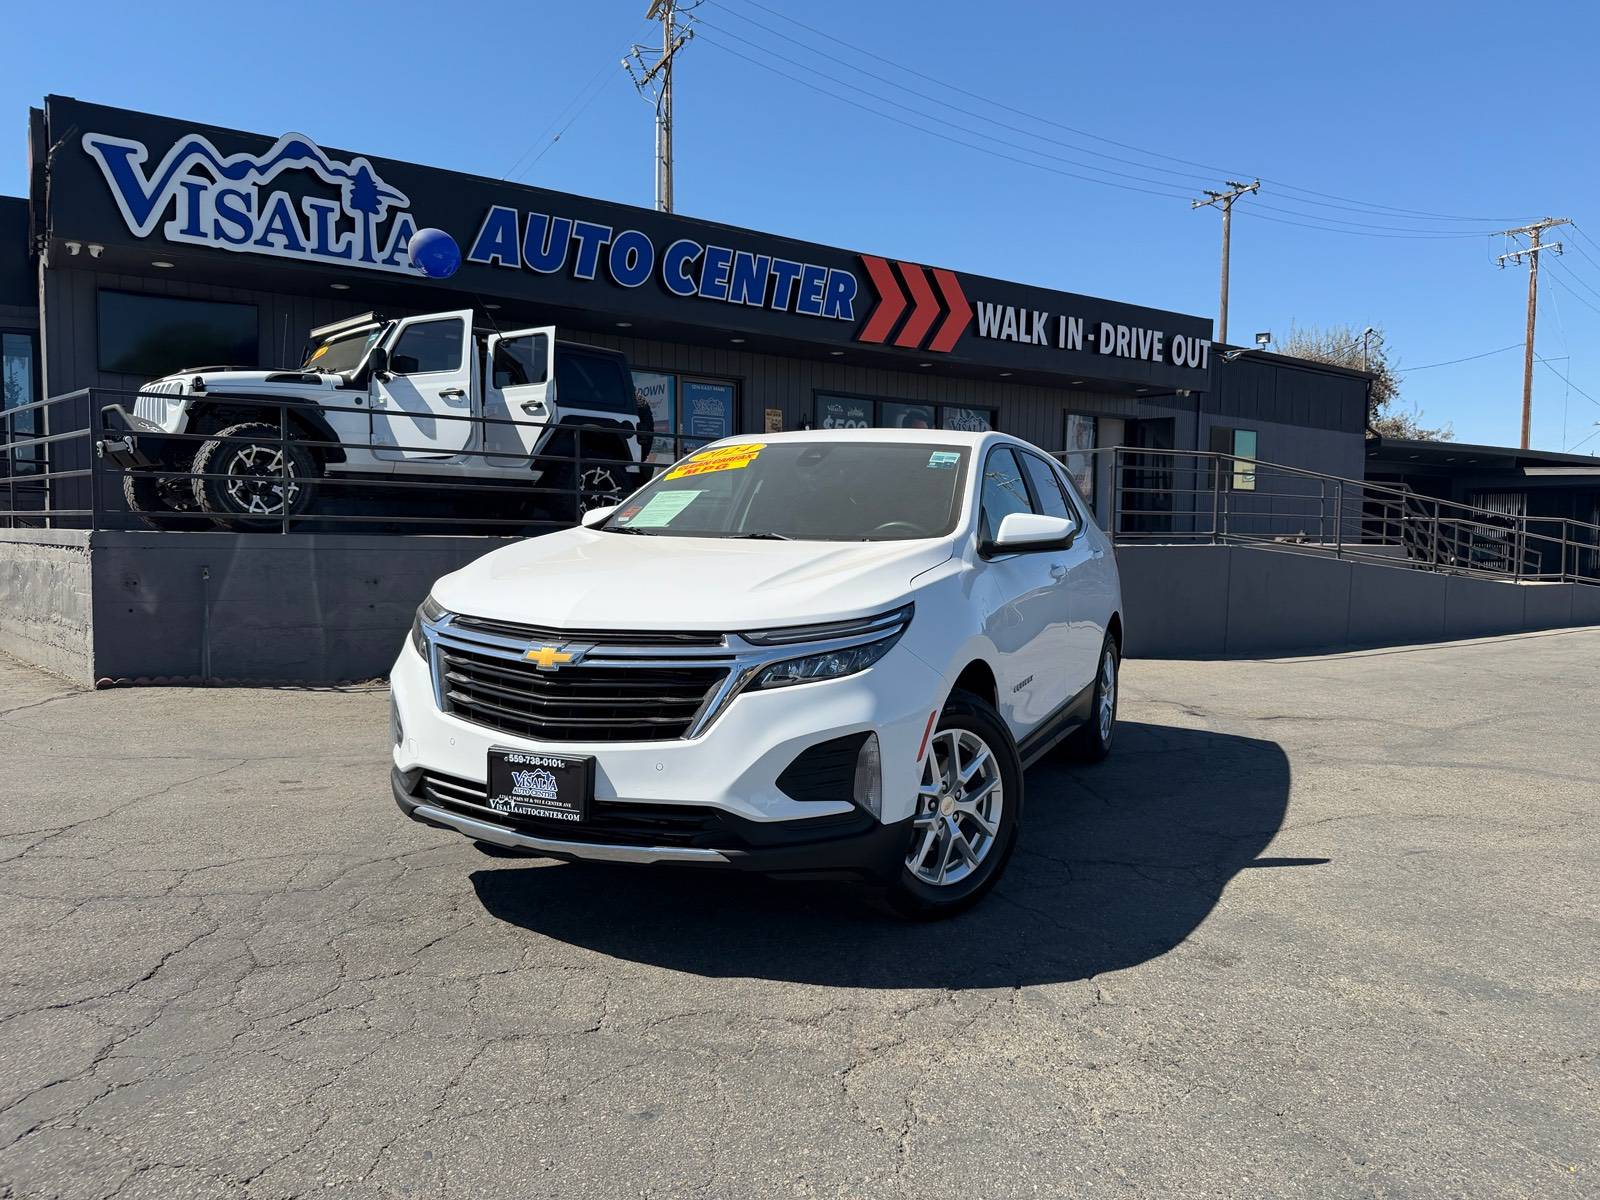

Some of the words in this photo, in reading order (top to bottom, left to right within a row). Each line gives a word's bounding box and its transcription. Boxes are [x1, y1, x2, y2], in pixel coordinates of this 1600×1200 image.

[82, 132, 422, 275] VISALIA
[467, 205, 655, 288] AUTO
[663, 239, 858, 321] CENTER
[977, 301, 1049, 346] WALK
[1171, 335, 1211, 369] OUT
[508, 754, 562, 768] 559-738-0101
[511, 768, 558, 792] VISALIA
[512, 787, 531, 796] AUTO
[531, 788, 558, 799] CENTER
